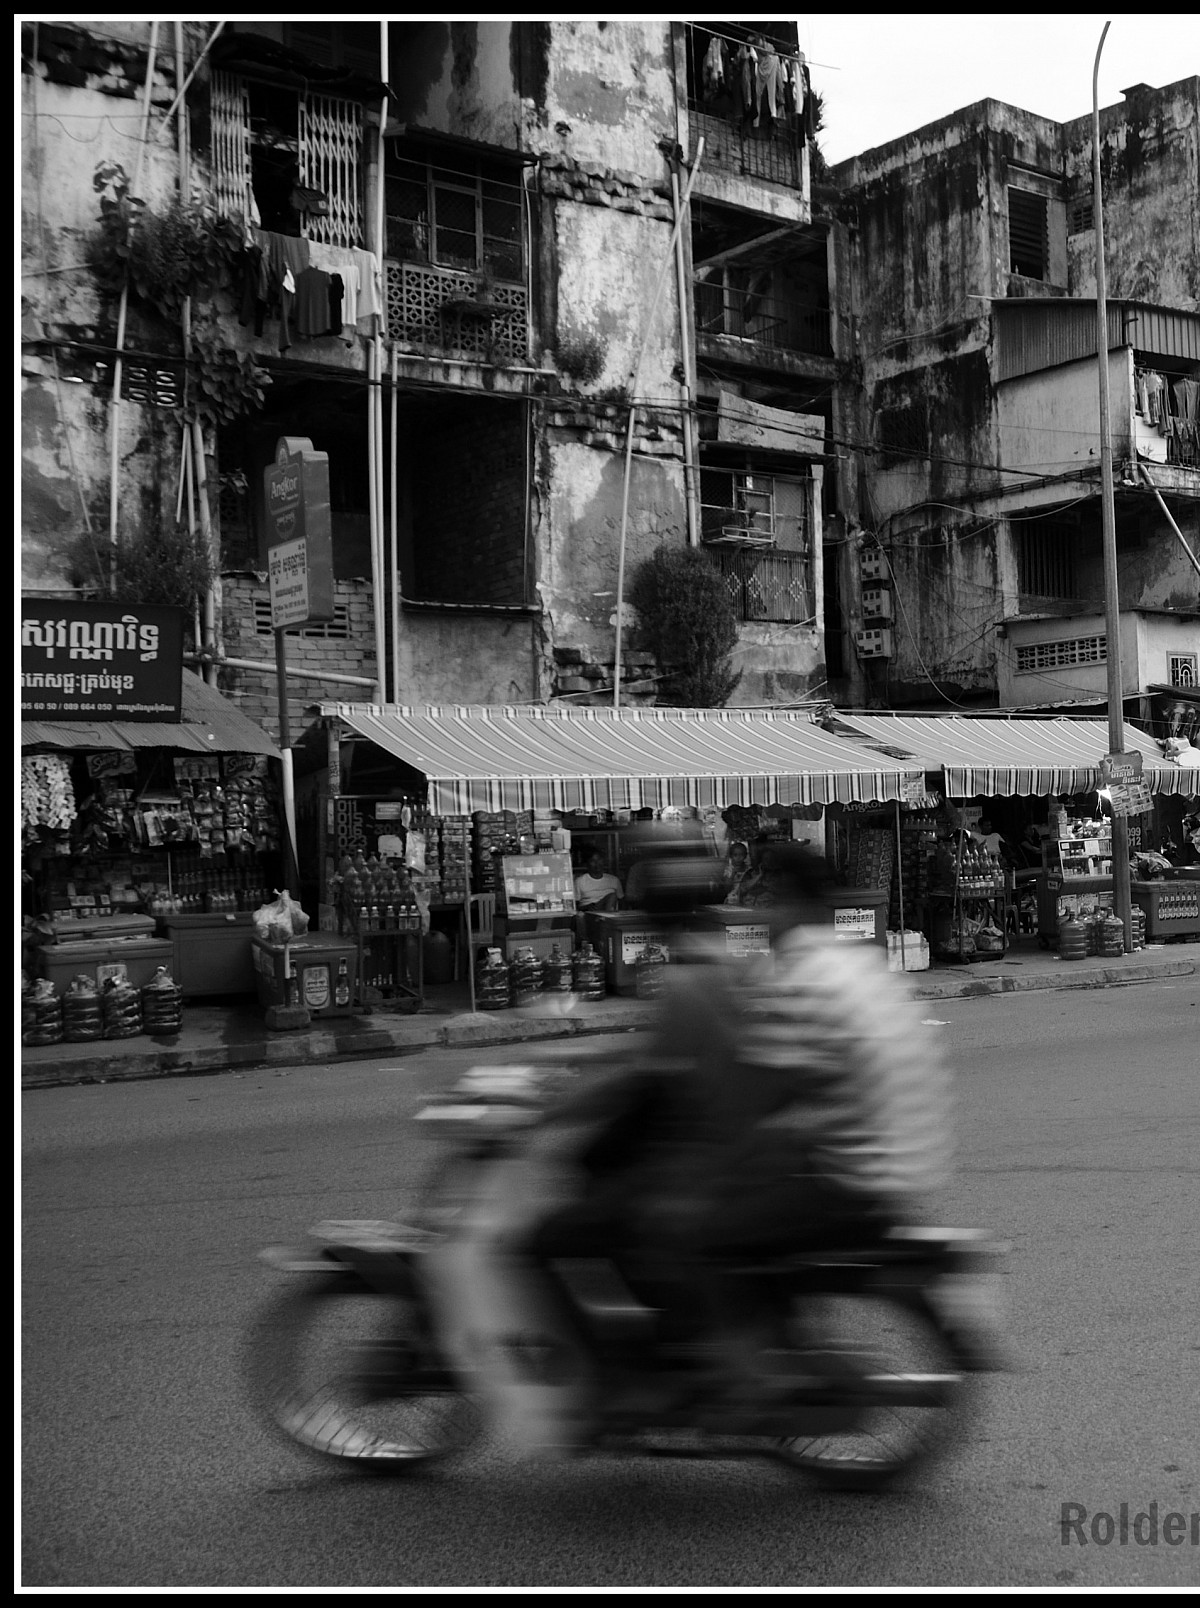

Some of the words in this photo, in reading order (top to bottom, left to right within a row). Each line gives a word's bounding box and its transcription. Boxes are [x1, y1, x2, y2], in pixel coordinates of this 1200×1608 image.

[271, 476, 298, 501] Angkor
[337, 800, 357, 812] 011
[338, 812, 364, 824] 015
[338, 824, 363, 836] 016
[338, 835, 367, 847] 023
